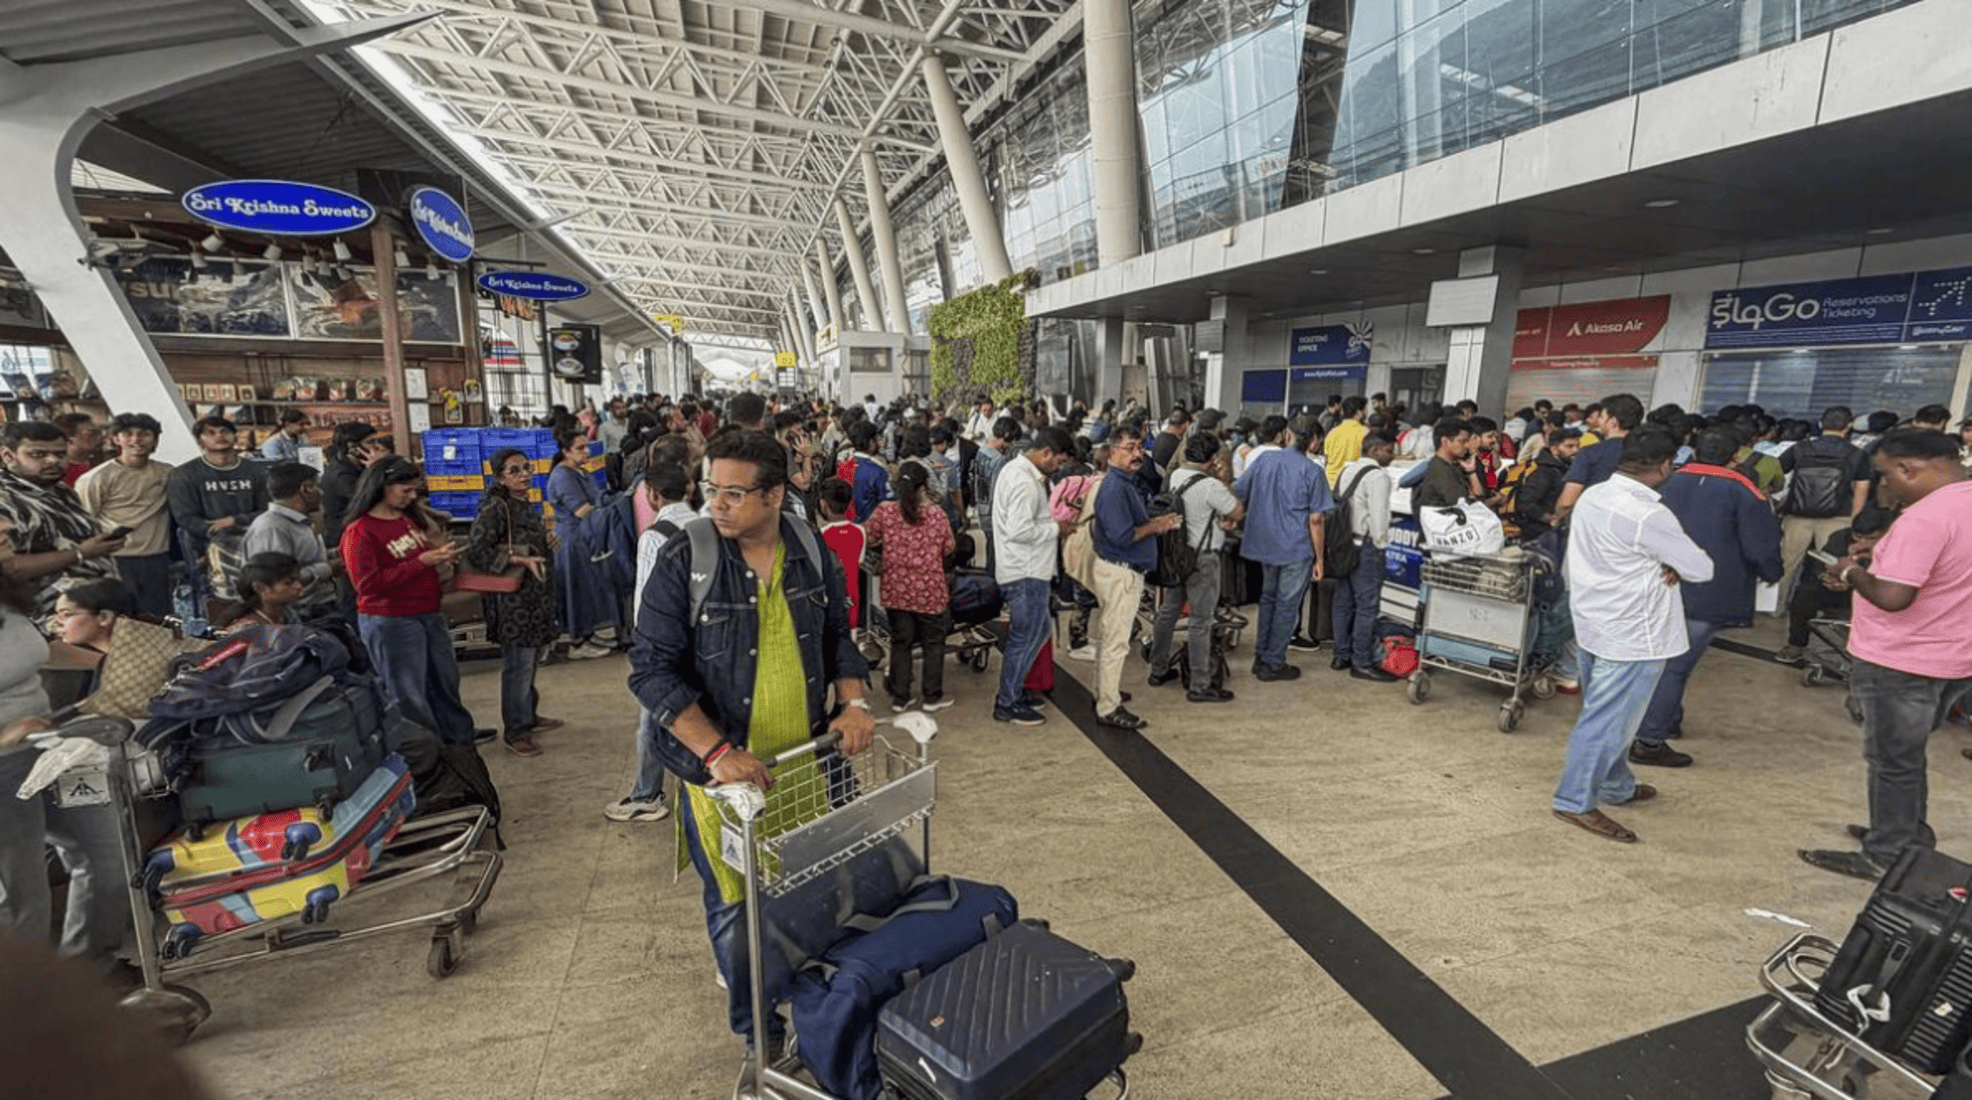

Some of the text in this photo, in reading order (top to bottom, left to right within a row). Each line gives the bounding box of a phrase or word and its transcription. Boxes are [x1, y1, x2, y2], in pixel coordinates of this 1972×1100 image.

[190, 192, 369, 219] Sri Krishna Sweets
[488, 276, 578, 293] Sri Krishna Sweets
[1822, 293, 1908, 308] Reservations
[1821, 306, 1877, 320] Ticketing
[1584, 319, 1643, 335] Akasa Air
